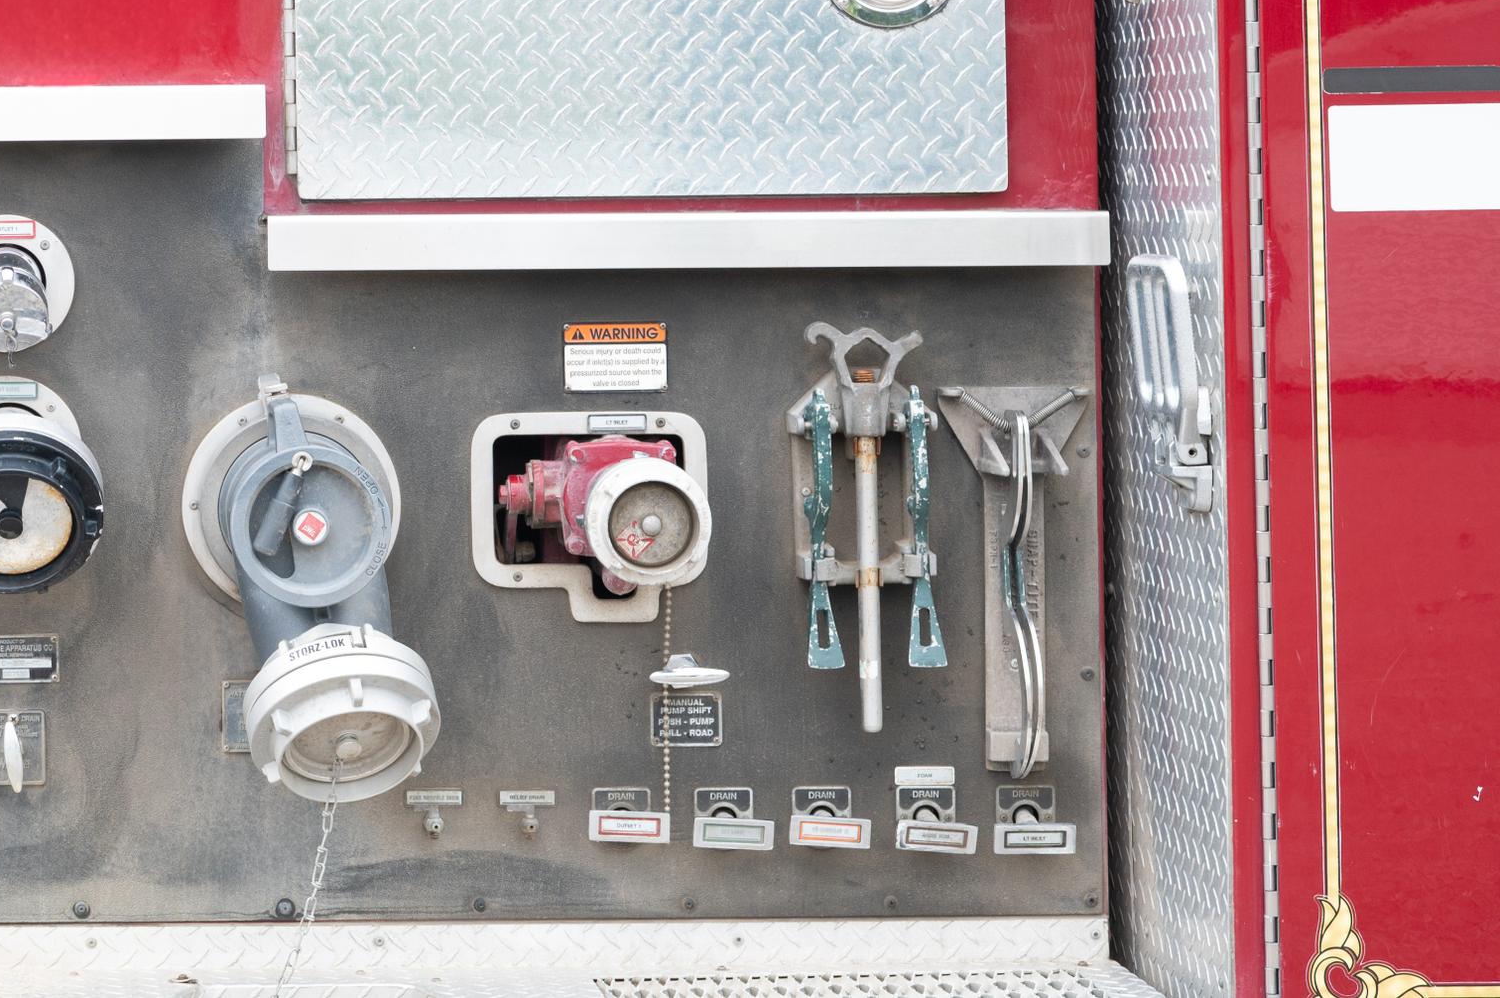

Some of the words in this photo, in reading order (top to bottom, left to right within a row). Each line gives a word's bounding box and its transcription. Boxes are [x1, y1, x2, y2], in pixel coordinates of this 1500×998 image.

[590, 327, 658, 340] WARNING
[570, 347, 594, 355] Serious
[596, 347, 613, 356] injury
[643, 346, 661, 354] could
[622, 358, 650, 367] supplied
[651, 357, 660, 366] by
[570, 369, 607, 378] pressurized
[633, 368, 650, 376] when
[354, 467, 379, 495] OPEN
[366, 542, 388, 577] CLOSE
[6, 644, 42, 652] APPARATUS
[43, 644, 53, 652] CO
[289, 638, 345, 662] STORZ-LOK
[666, 698, 704, 706] MANUAL
[660, 706, 686, 714] PUMP
[687, 706, 712, 714] SHIFT
[689, 717, 715, 725] PUMP
[689, 729, 714, 737] ROAD
[608, 792, 635, 800] DRAIN
[710, 791, 738, 800] DRAIN
[808, 791, 836, 799] DRAIN
[912, 790, 940, 799] DRAIN
[1012, 789, 1040, 798] DRAIN
